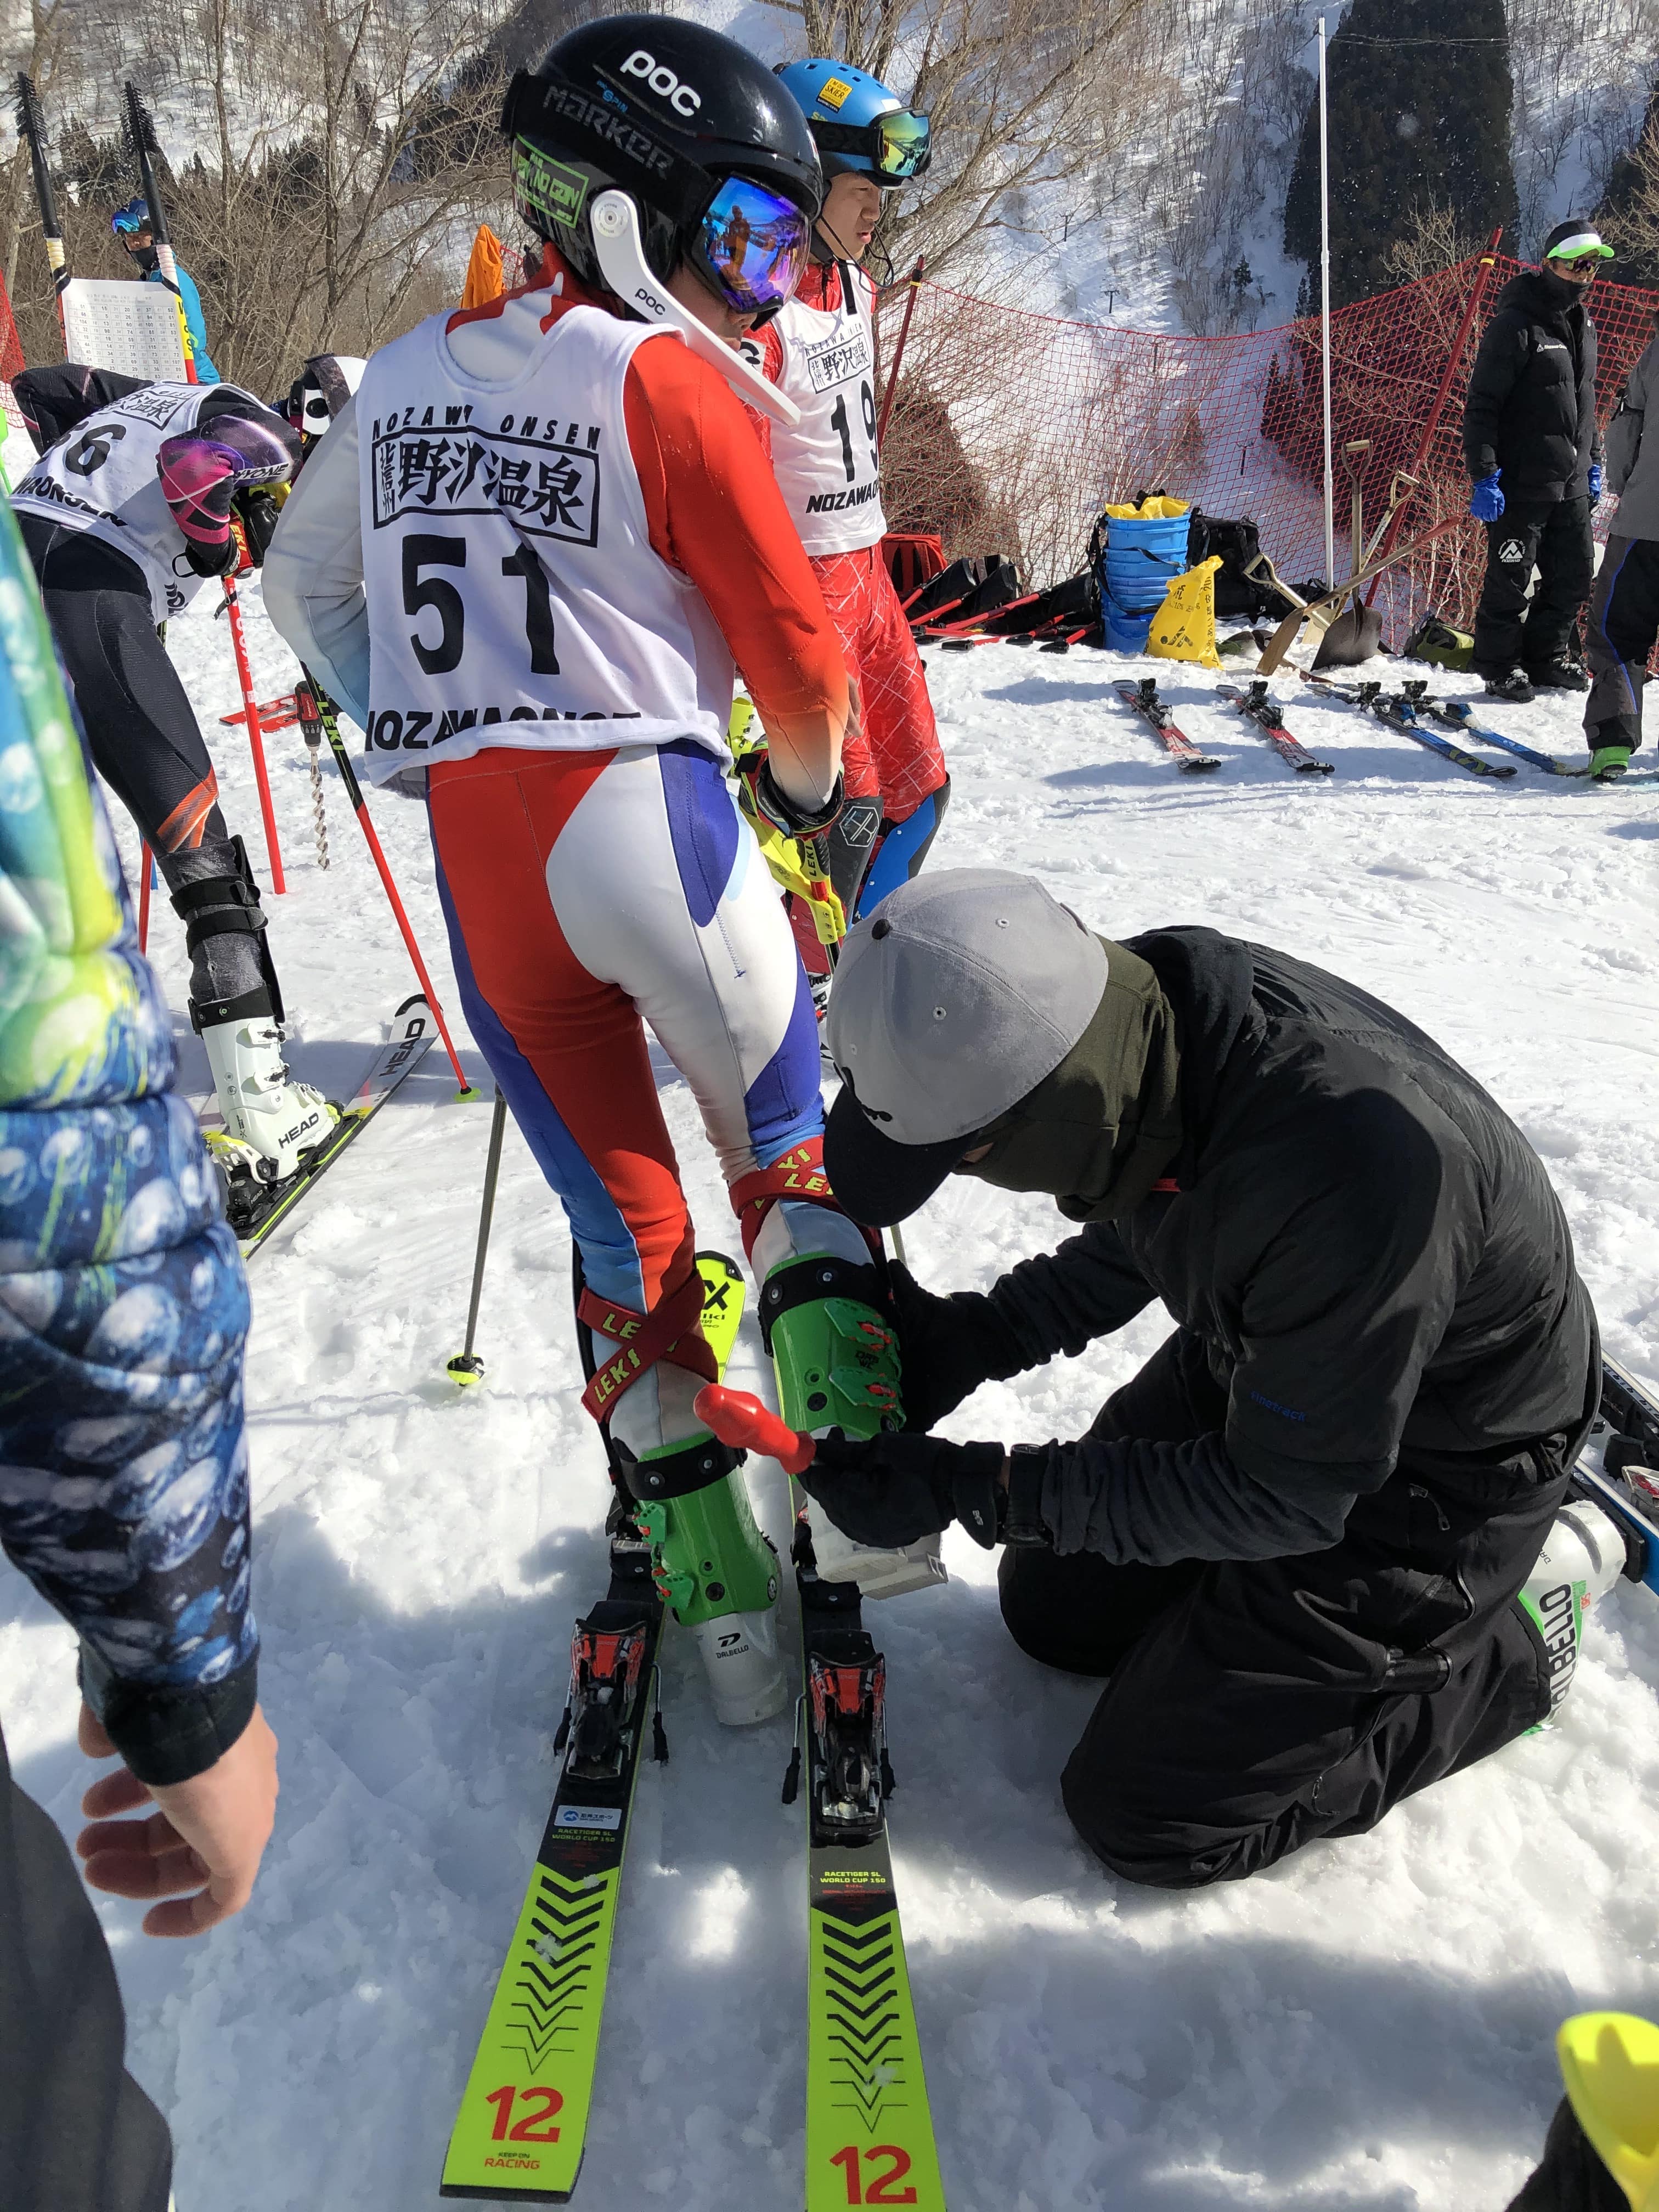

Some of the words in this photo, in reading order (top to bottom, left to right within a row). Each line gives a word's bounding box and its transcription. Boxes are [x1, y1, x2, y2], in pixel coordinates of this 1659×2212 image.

[543, 85, 674, 180] MARKER
[500, 414, 601, 451] ONSEN
[831, 380, 879, 483] 19
[805, 483, 879, 514] NOZAWAO
[229, 524, 247, 552] EKI
[402, 534, 560, 675] 51
[317, 701, 345, 751] LEKI
[805, 845, 817, 877] LEKI
[379, 1018, 426, 1076] HEAD
[278, 1113, 319, 1149] HEAD
[785, 1173, 834, 1196] LE
[602, 1312, 642, 1340] LE
[594, 1348, 642, 1404] LEKI
[716, 1644, 749, 1659] DALBELLO
[1539, 1583, 1577, 1722] ALBELLO
[486, 2086, 563, 2143] 12
[484, 2158, 540, 2169] RACING
[830, 2145, 917, 2205] 12
